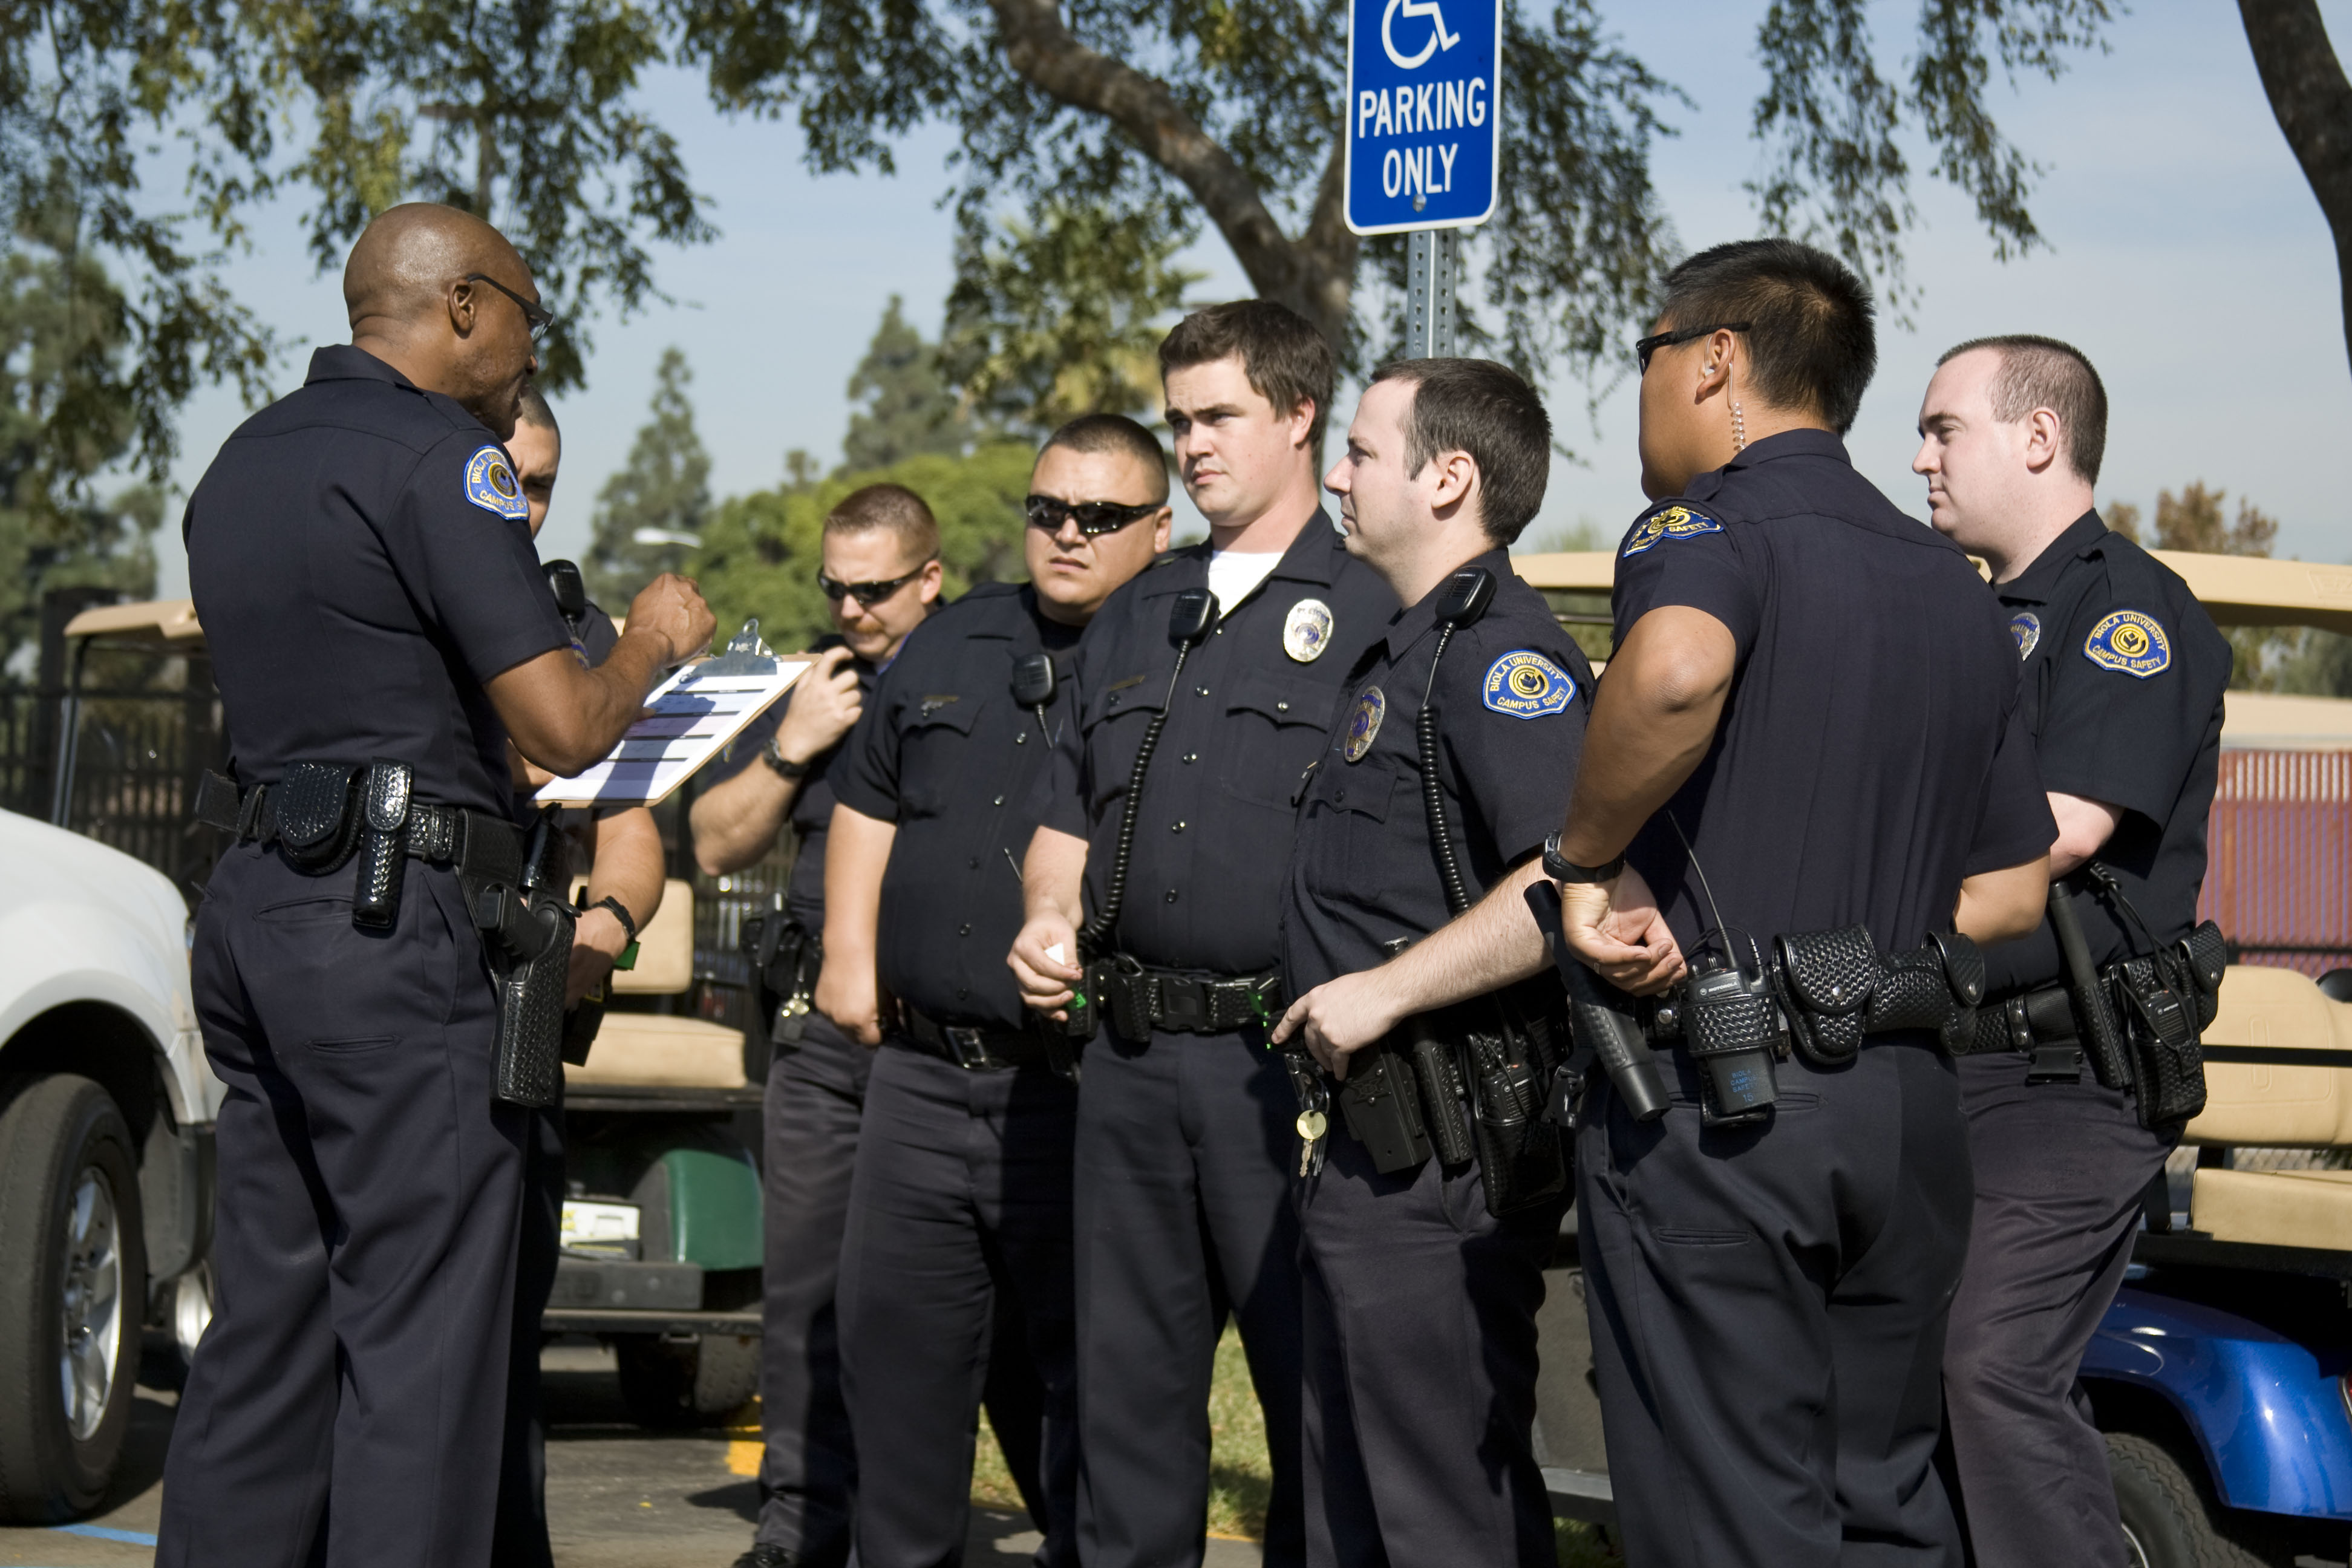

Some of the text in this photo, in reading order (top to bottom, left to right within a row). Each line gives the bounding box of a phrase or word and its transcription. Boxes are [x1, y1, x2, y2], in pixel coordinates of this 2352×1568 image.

[1359, 77, 1486, 139] PARKING
[1383, 143, 1459, 198] ONLY
[472, 458, 488, 483] BIOLA
[479, 490, 515, 511] CAMPUS
[1668, 522, 1708, 532] SAFETY
[2094, 615, 2166, 651] BIOLA UNIVERSITY
[2092, 645, 2161, 669] CAMPUS SAFETY
[1490, 656, 1562, 691] BIOLA UNIVERSITY
[1497, 685, 1566, 710] CAMPUS SAFETY
[1708, 981, 1737, 992] MOTOROLA
[1730, 1074, 1757, 1086] CAMPUS
